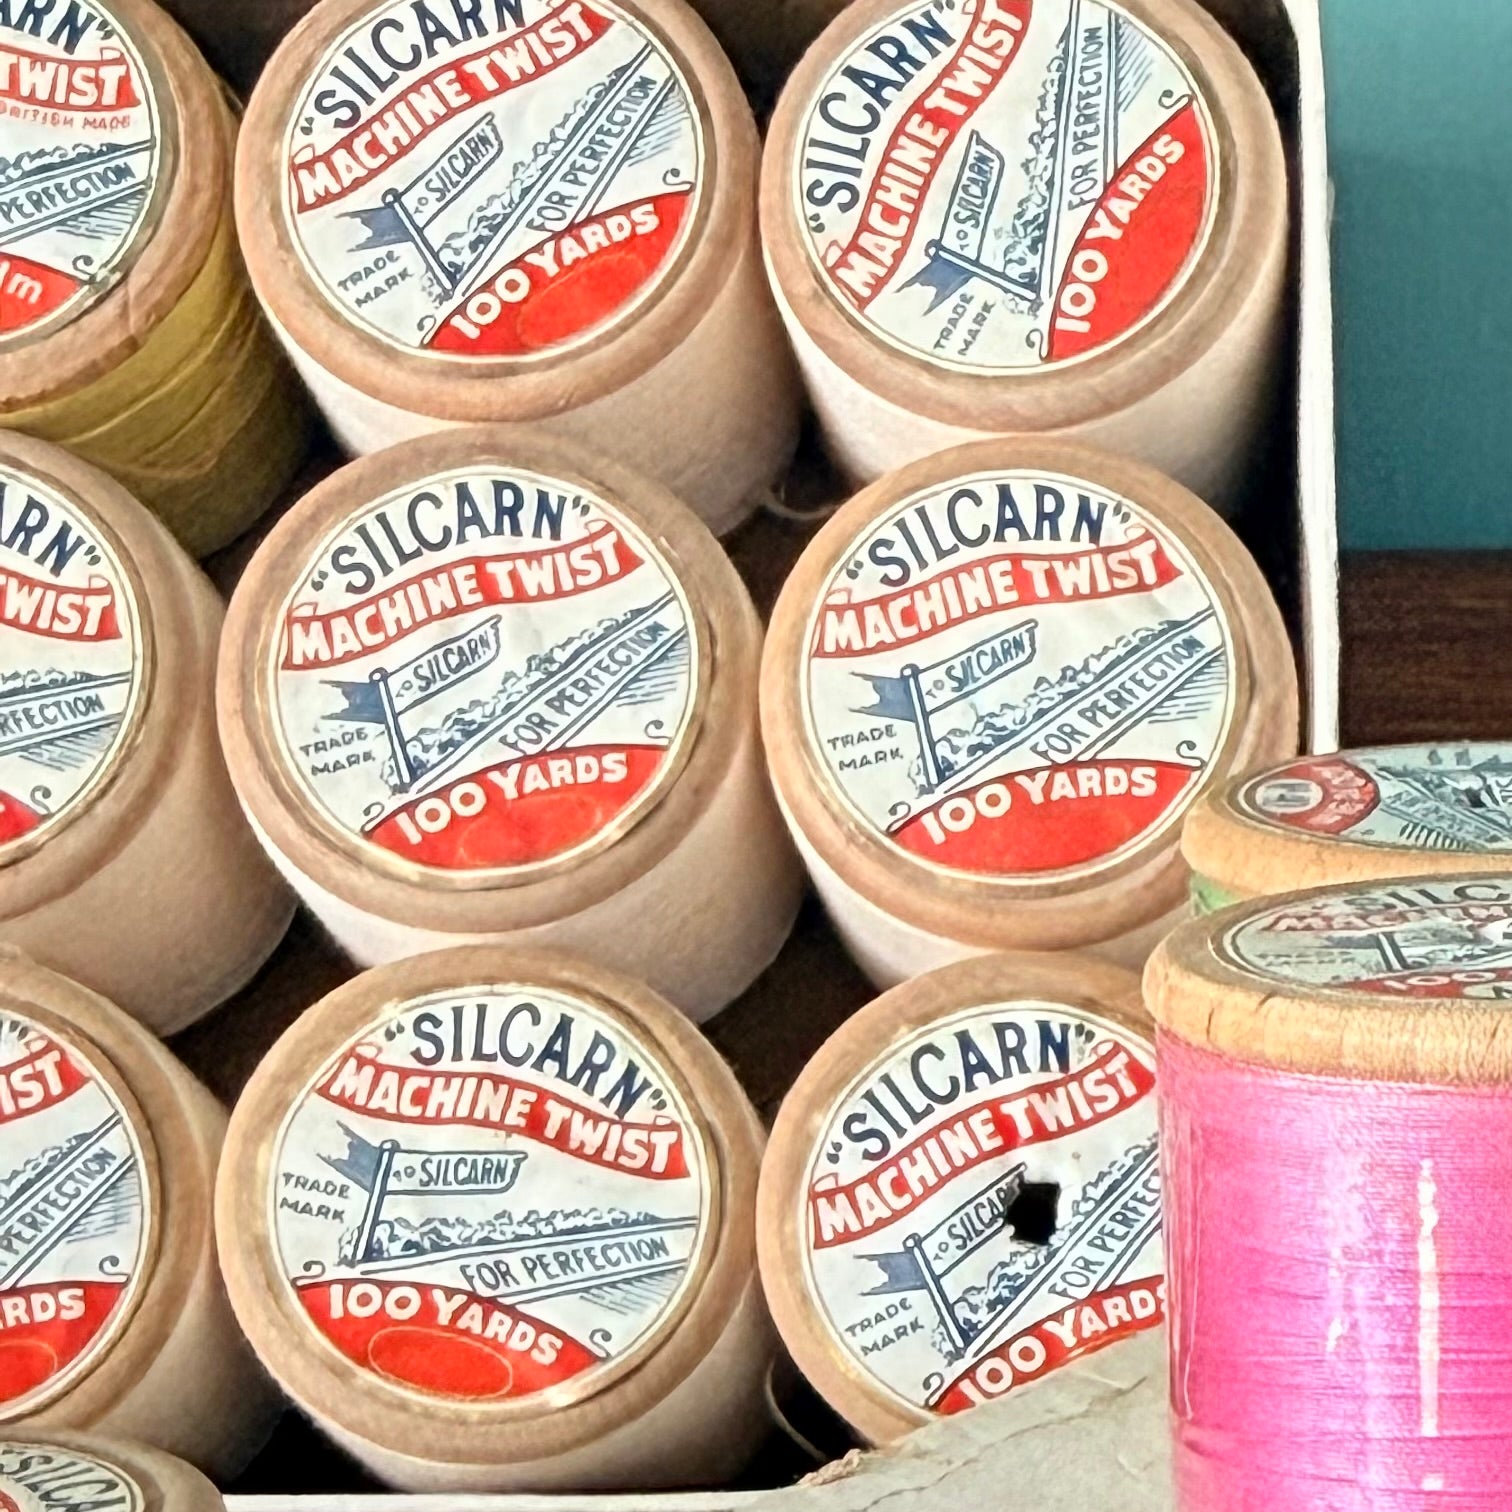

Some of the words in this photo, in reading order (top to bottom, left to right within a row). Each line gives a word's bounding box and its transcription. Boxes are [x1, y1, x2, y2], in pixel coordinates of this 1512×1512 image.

[298, 71, 471, 206] MACHINE
[462, 2, 593, 92] TWIST
[1071, 27, 1104, 156] PERFECTION
[414, 196, 430, 215] TO
[432, 125, 496, 205] SILCARN
[526, 186, 578, 233] FOR
[563, 75, 658, 190] PERFECTION
[835, 119, 950, 299] MACHINE
[923, 0, 1022, 116] TWIST
[965, 148, 998, 230] SILCARN
[1069, 157, 1099, 211] FOR
[1054, 250, 1109, 334] 100
[1085, 134, 1187, 241] YARDS
[338, 250, 402, 292] TRADE
[353, 267, 415, 309] MARK
[449, 266, 531, 340] 100
[524, 203, 660, 279] YARDS
[934, 293, 973, 350] TRADE
[957, 301, 997, 356] MARK
[0, 575, 111, 636] WIST
[290, 567, 486, 666] MACHINE
[486, 531, 623, 597] TWIST
[824, 558, 1018, 653] MACHINE
[1021, 543, 1159, 598] TWIST
[418, 631, 492, 693] SILCARN
[501, 708, 556, 754] FOR
[551, 622, 671, 718] PERFECTION
[947, 630, 1027, 692] SILCARN
[1031, 723, 1090, 762] FOR
[1086, 635, 1206, 729] PERFECTION
[300, 727, 368, 757] TRADE
[312, 751, 376, 775] MARK
[828, 725, 897, 750] TRADE
[839, 747, 903, 770] MARK
[395, 783, 488, 845] 100
[487, 753, 628, 800] YARDS
[921, 783, 1012, 845] 100
[1016, 767, 1156, 803] YARDS
[331, 1055, 537, 1128] MACHINE
[543, 1100, 677, 1174] TWIST
[419, 1157, 506, 1187] SILCARN
[816, 1108, 1004, 1243] MACHINE
[1000, 1050, 1139, 1140] TWIST
[279, 1197, 346, 1223] MARK
[282, 1171, 350, 1200] TRADE
[461, 1257, 517, 1293] FOR
[527, 1236, 671, 1287] PERFECTION
[933, 1241, 950, 1261] TO
[1048, 1256, 1105, 1300] FOR
[329, 1284, 421, 1320] 100
[431, 1289, 564, 1366] YARDS
[845, 1298, 913, 1337] TRADE
[860, 1316, 925, 1356] MARK
[959, 1342, 1046, 1405] 100
